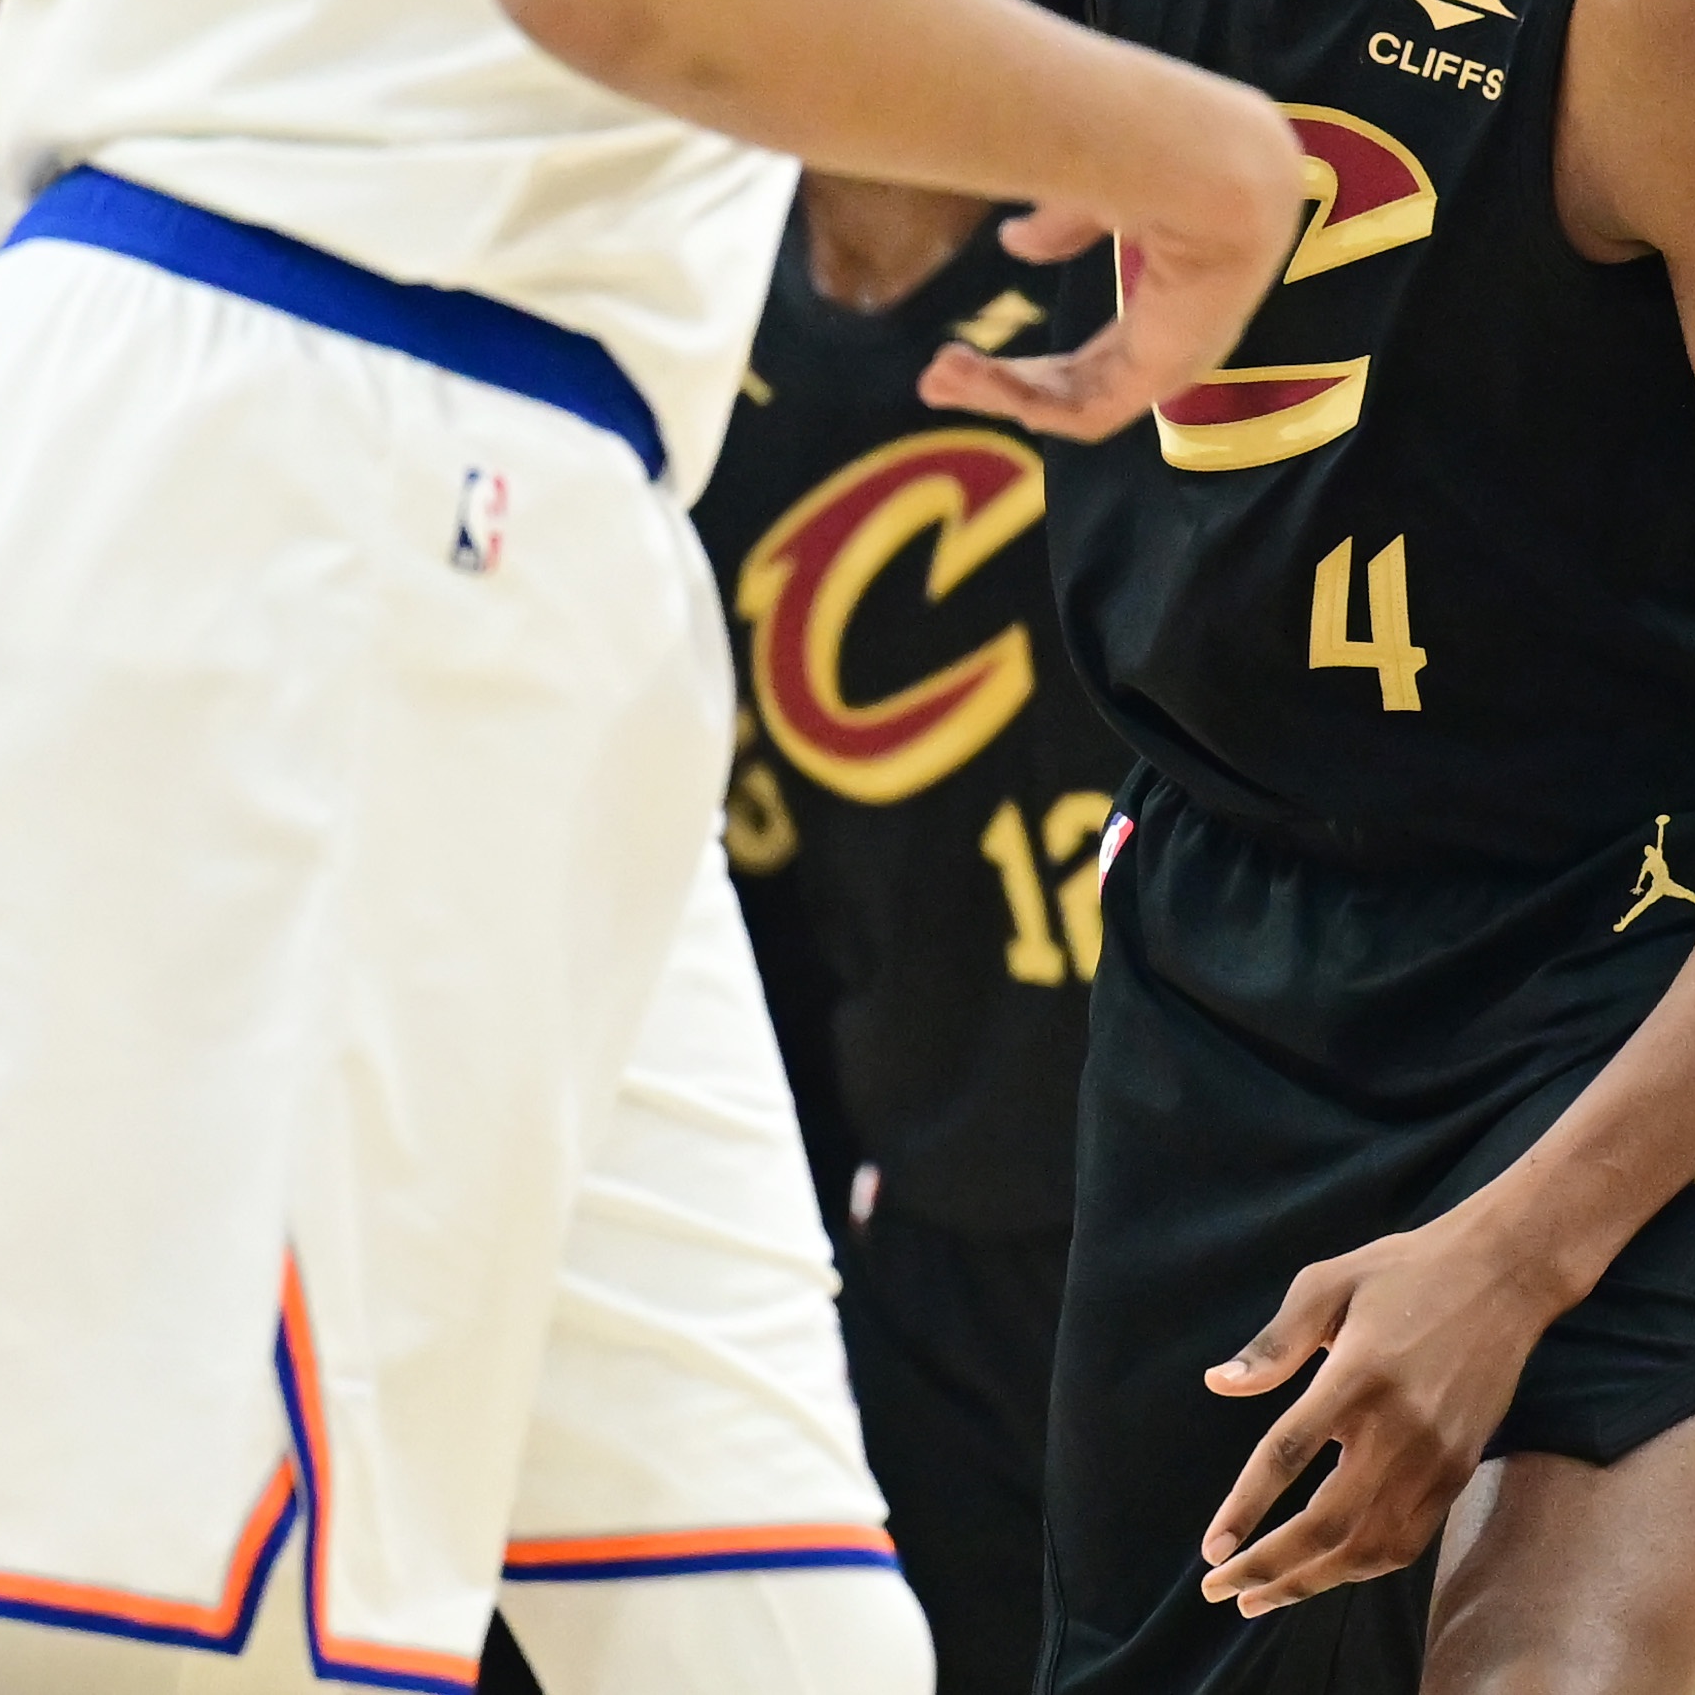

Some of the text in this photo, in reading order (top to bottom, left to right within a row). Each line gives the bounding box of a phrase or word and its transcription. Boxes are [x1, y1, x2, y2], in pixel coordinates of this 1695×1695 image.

[1367, 31, 1505, 101] CLIFFS
[735, 426, 1046, 805] C
[1309, 532, 1428, 712] 4
